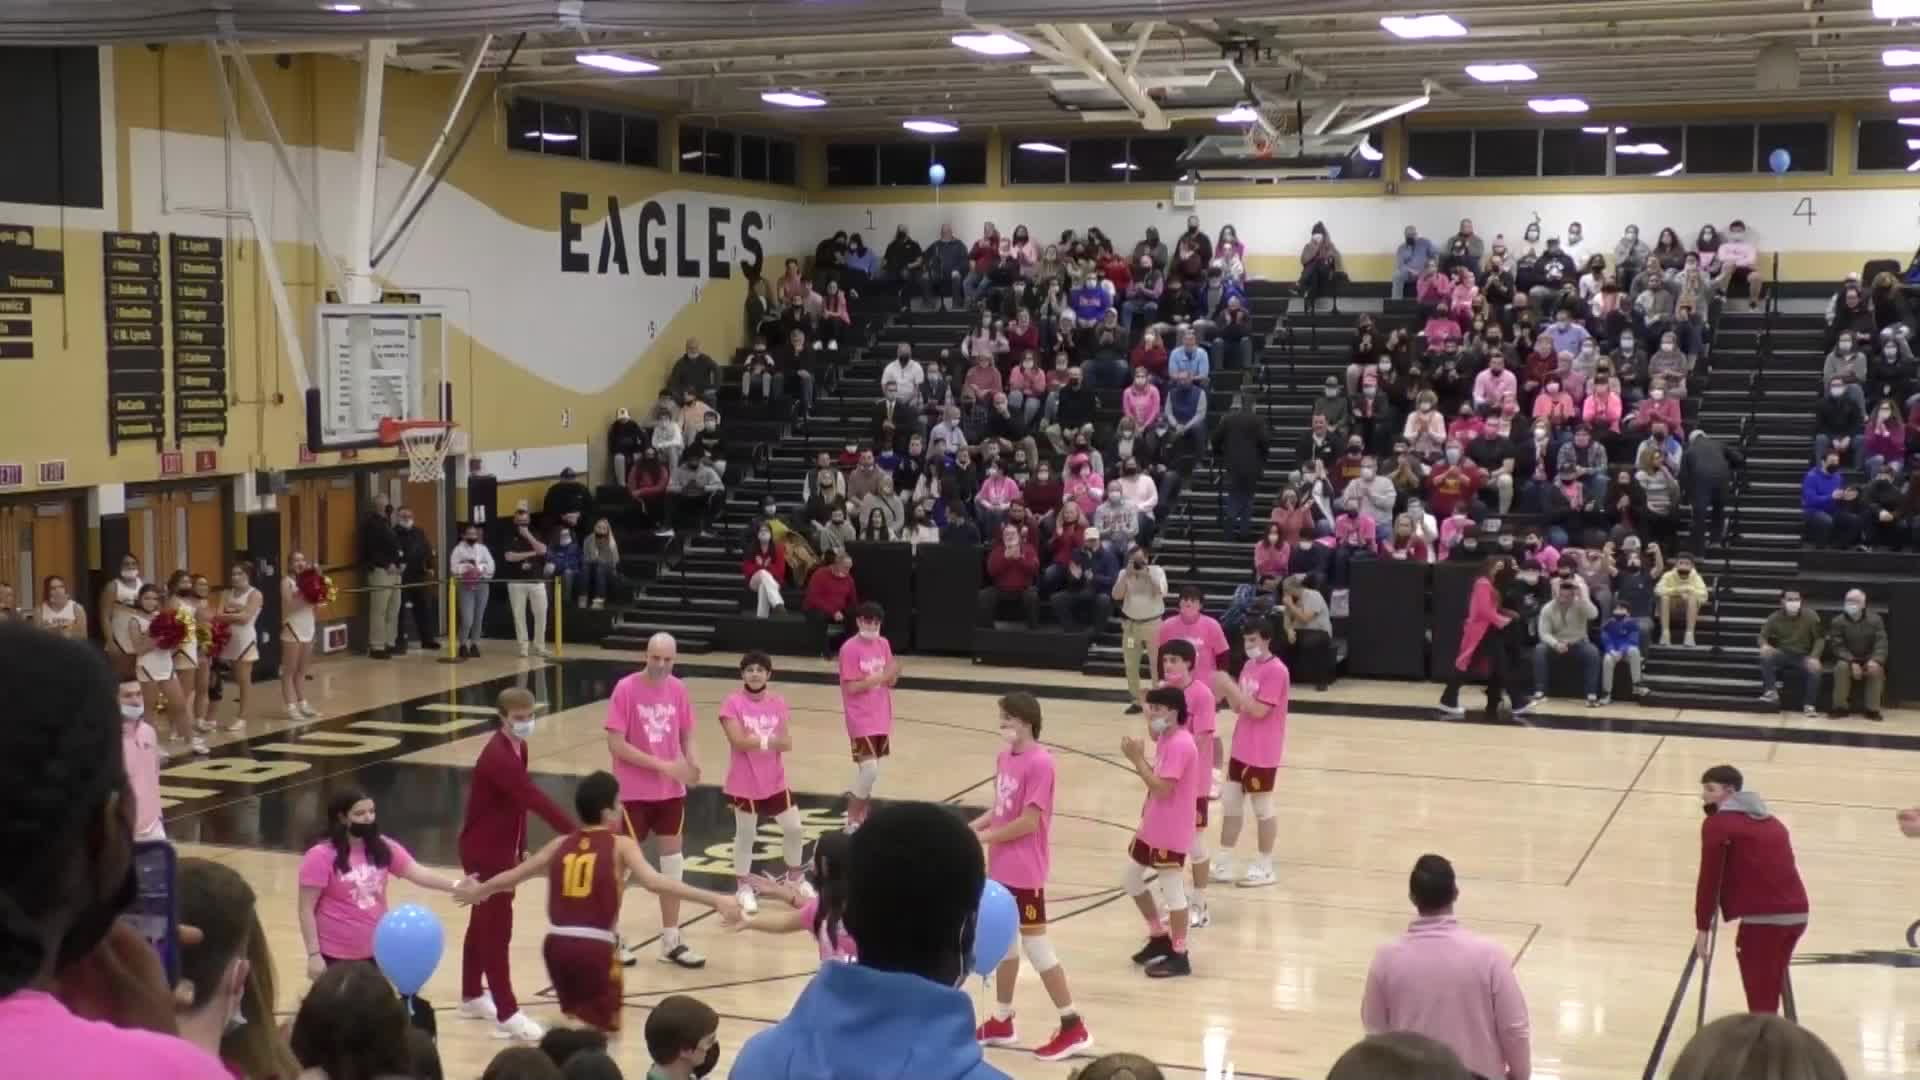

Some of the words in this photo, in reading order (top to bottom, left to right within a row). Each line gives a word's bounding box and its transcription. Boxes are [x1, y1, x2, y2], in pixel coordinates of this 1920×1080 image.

[1792, 197, 1816, 226] 4
[560, 191, 764, 281] EAGLES
[562, 852, 598, 897] 10
